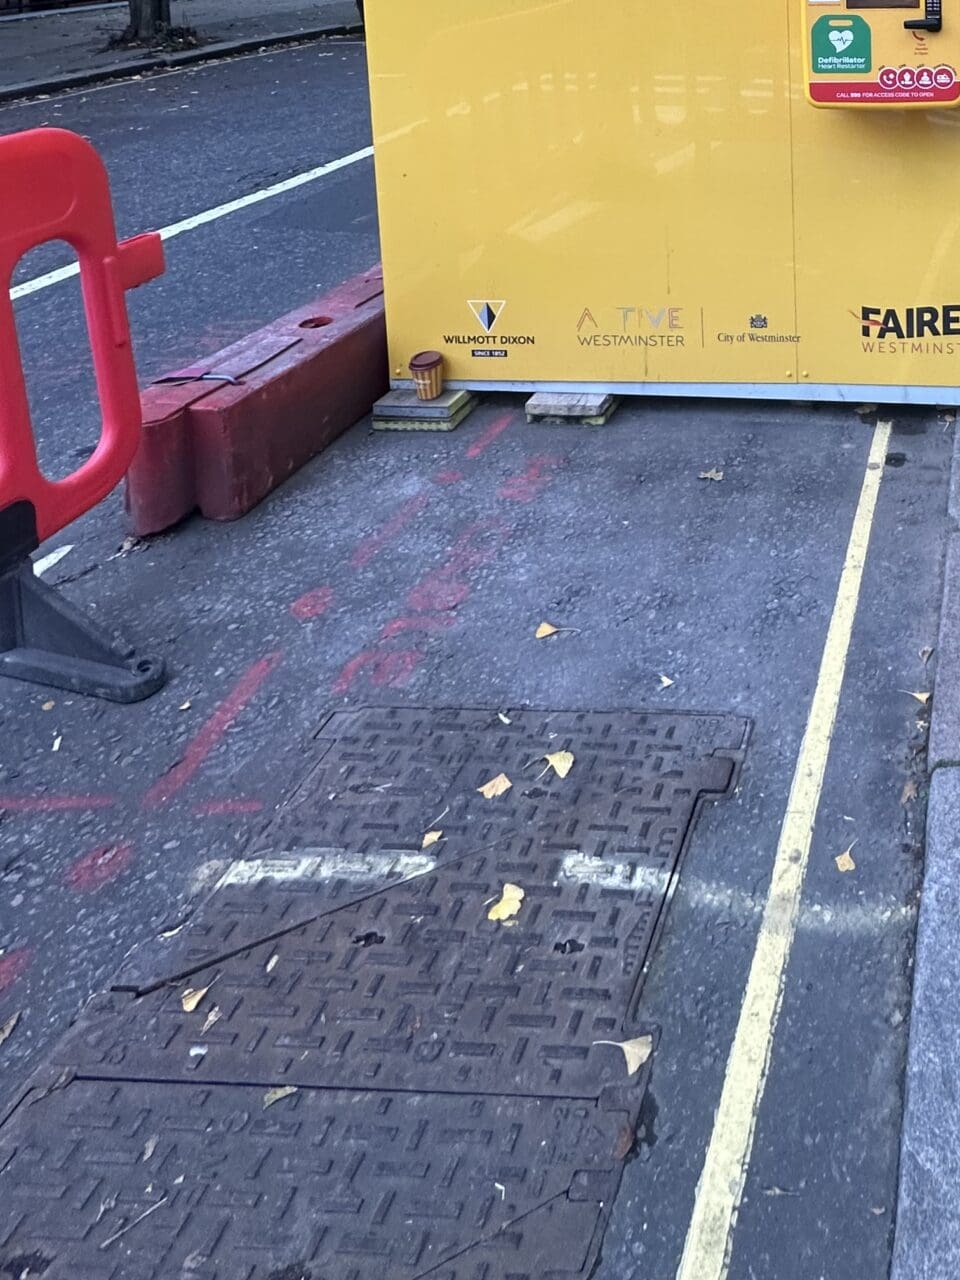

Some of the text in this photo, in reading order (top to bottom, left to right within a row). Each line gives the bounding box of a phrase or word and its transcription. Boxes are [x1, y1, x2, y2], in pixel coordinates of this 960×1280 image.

[444, 335, 535, 344] WILLMOTT DIXON
[577, 335, 685, 347] WESTMINSTER
[717, 333, 801, 344] City of Westminster
